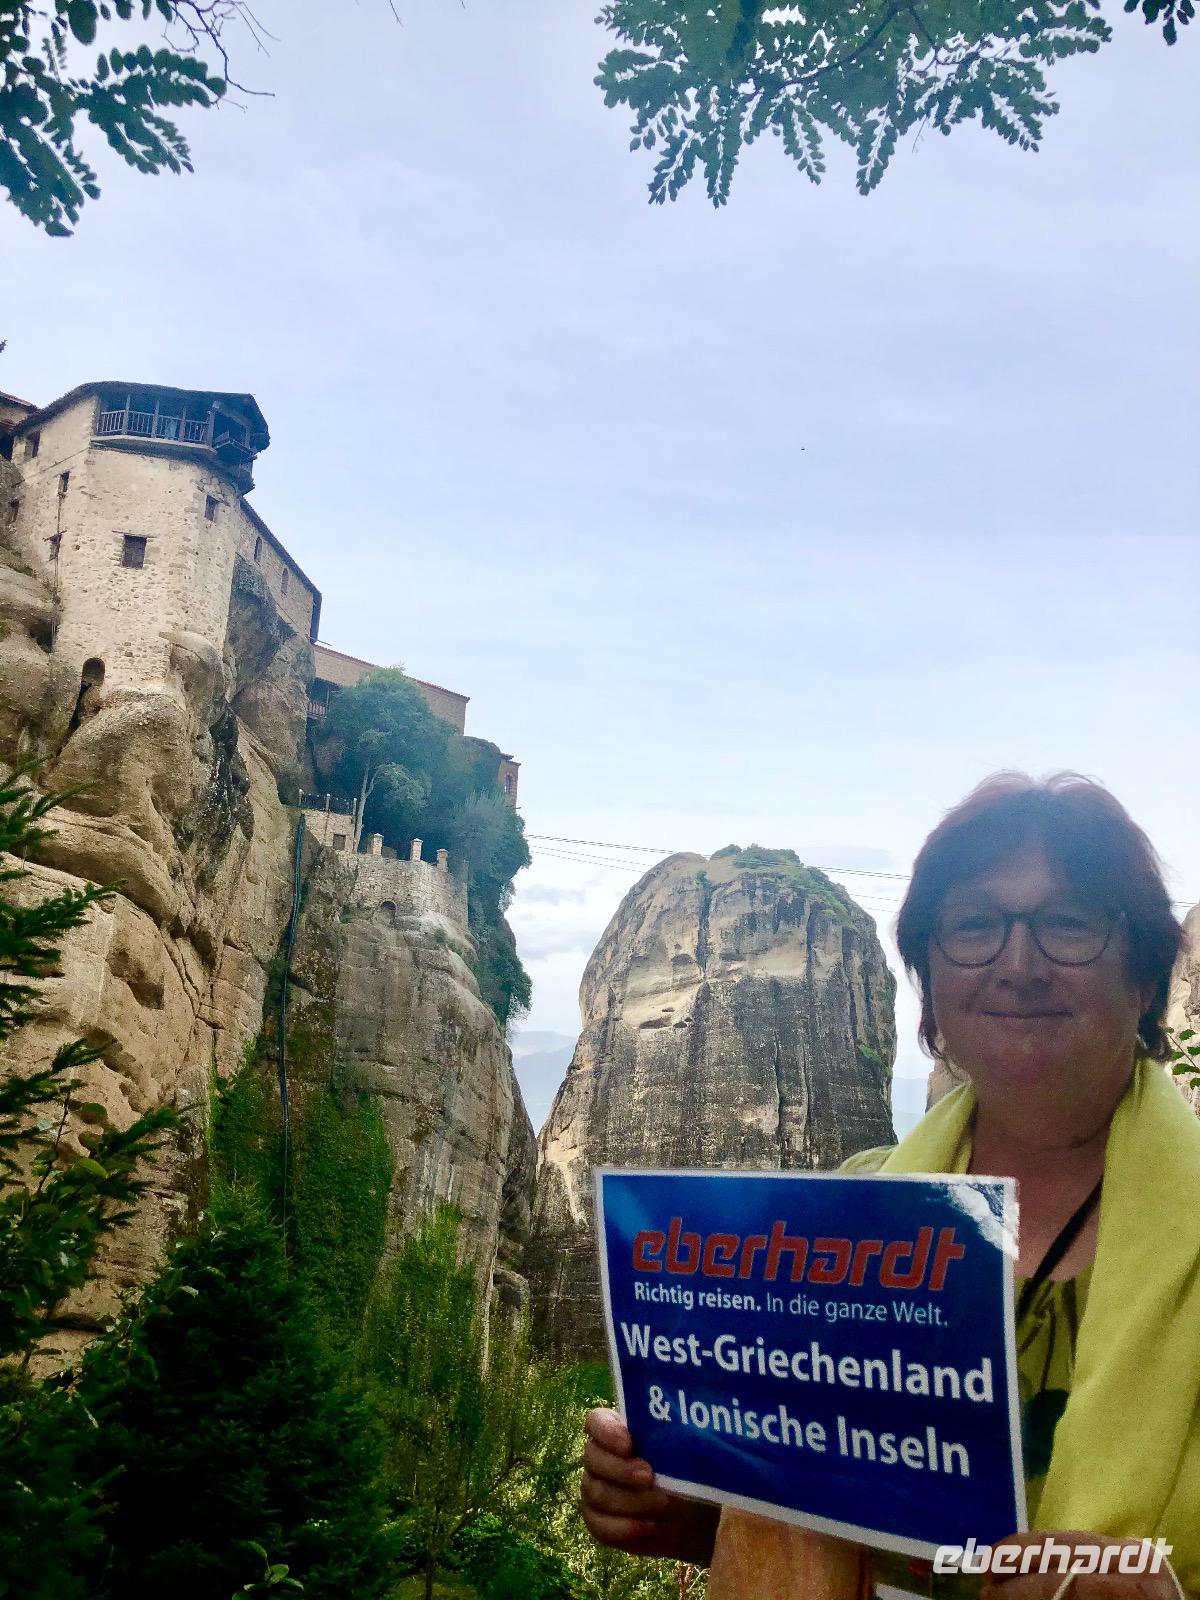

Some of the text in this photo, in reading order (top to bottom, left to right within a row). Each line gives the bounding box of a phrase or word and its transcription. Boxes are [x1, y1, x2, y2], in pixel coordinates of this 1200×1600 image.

[632, 1217, 966, 1291] eberhardt
[634, 1281, 949, 1327] Richtig reisen. In die ganze Welt.
[620, 1321, 994, 1403] West-Griechenland
[648, 1384, 971, 1478] & Ionische Inseln
